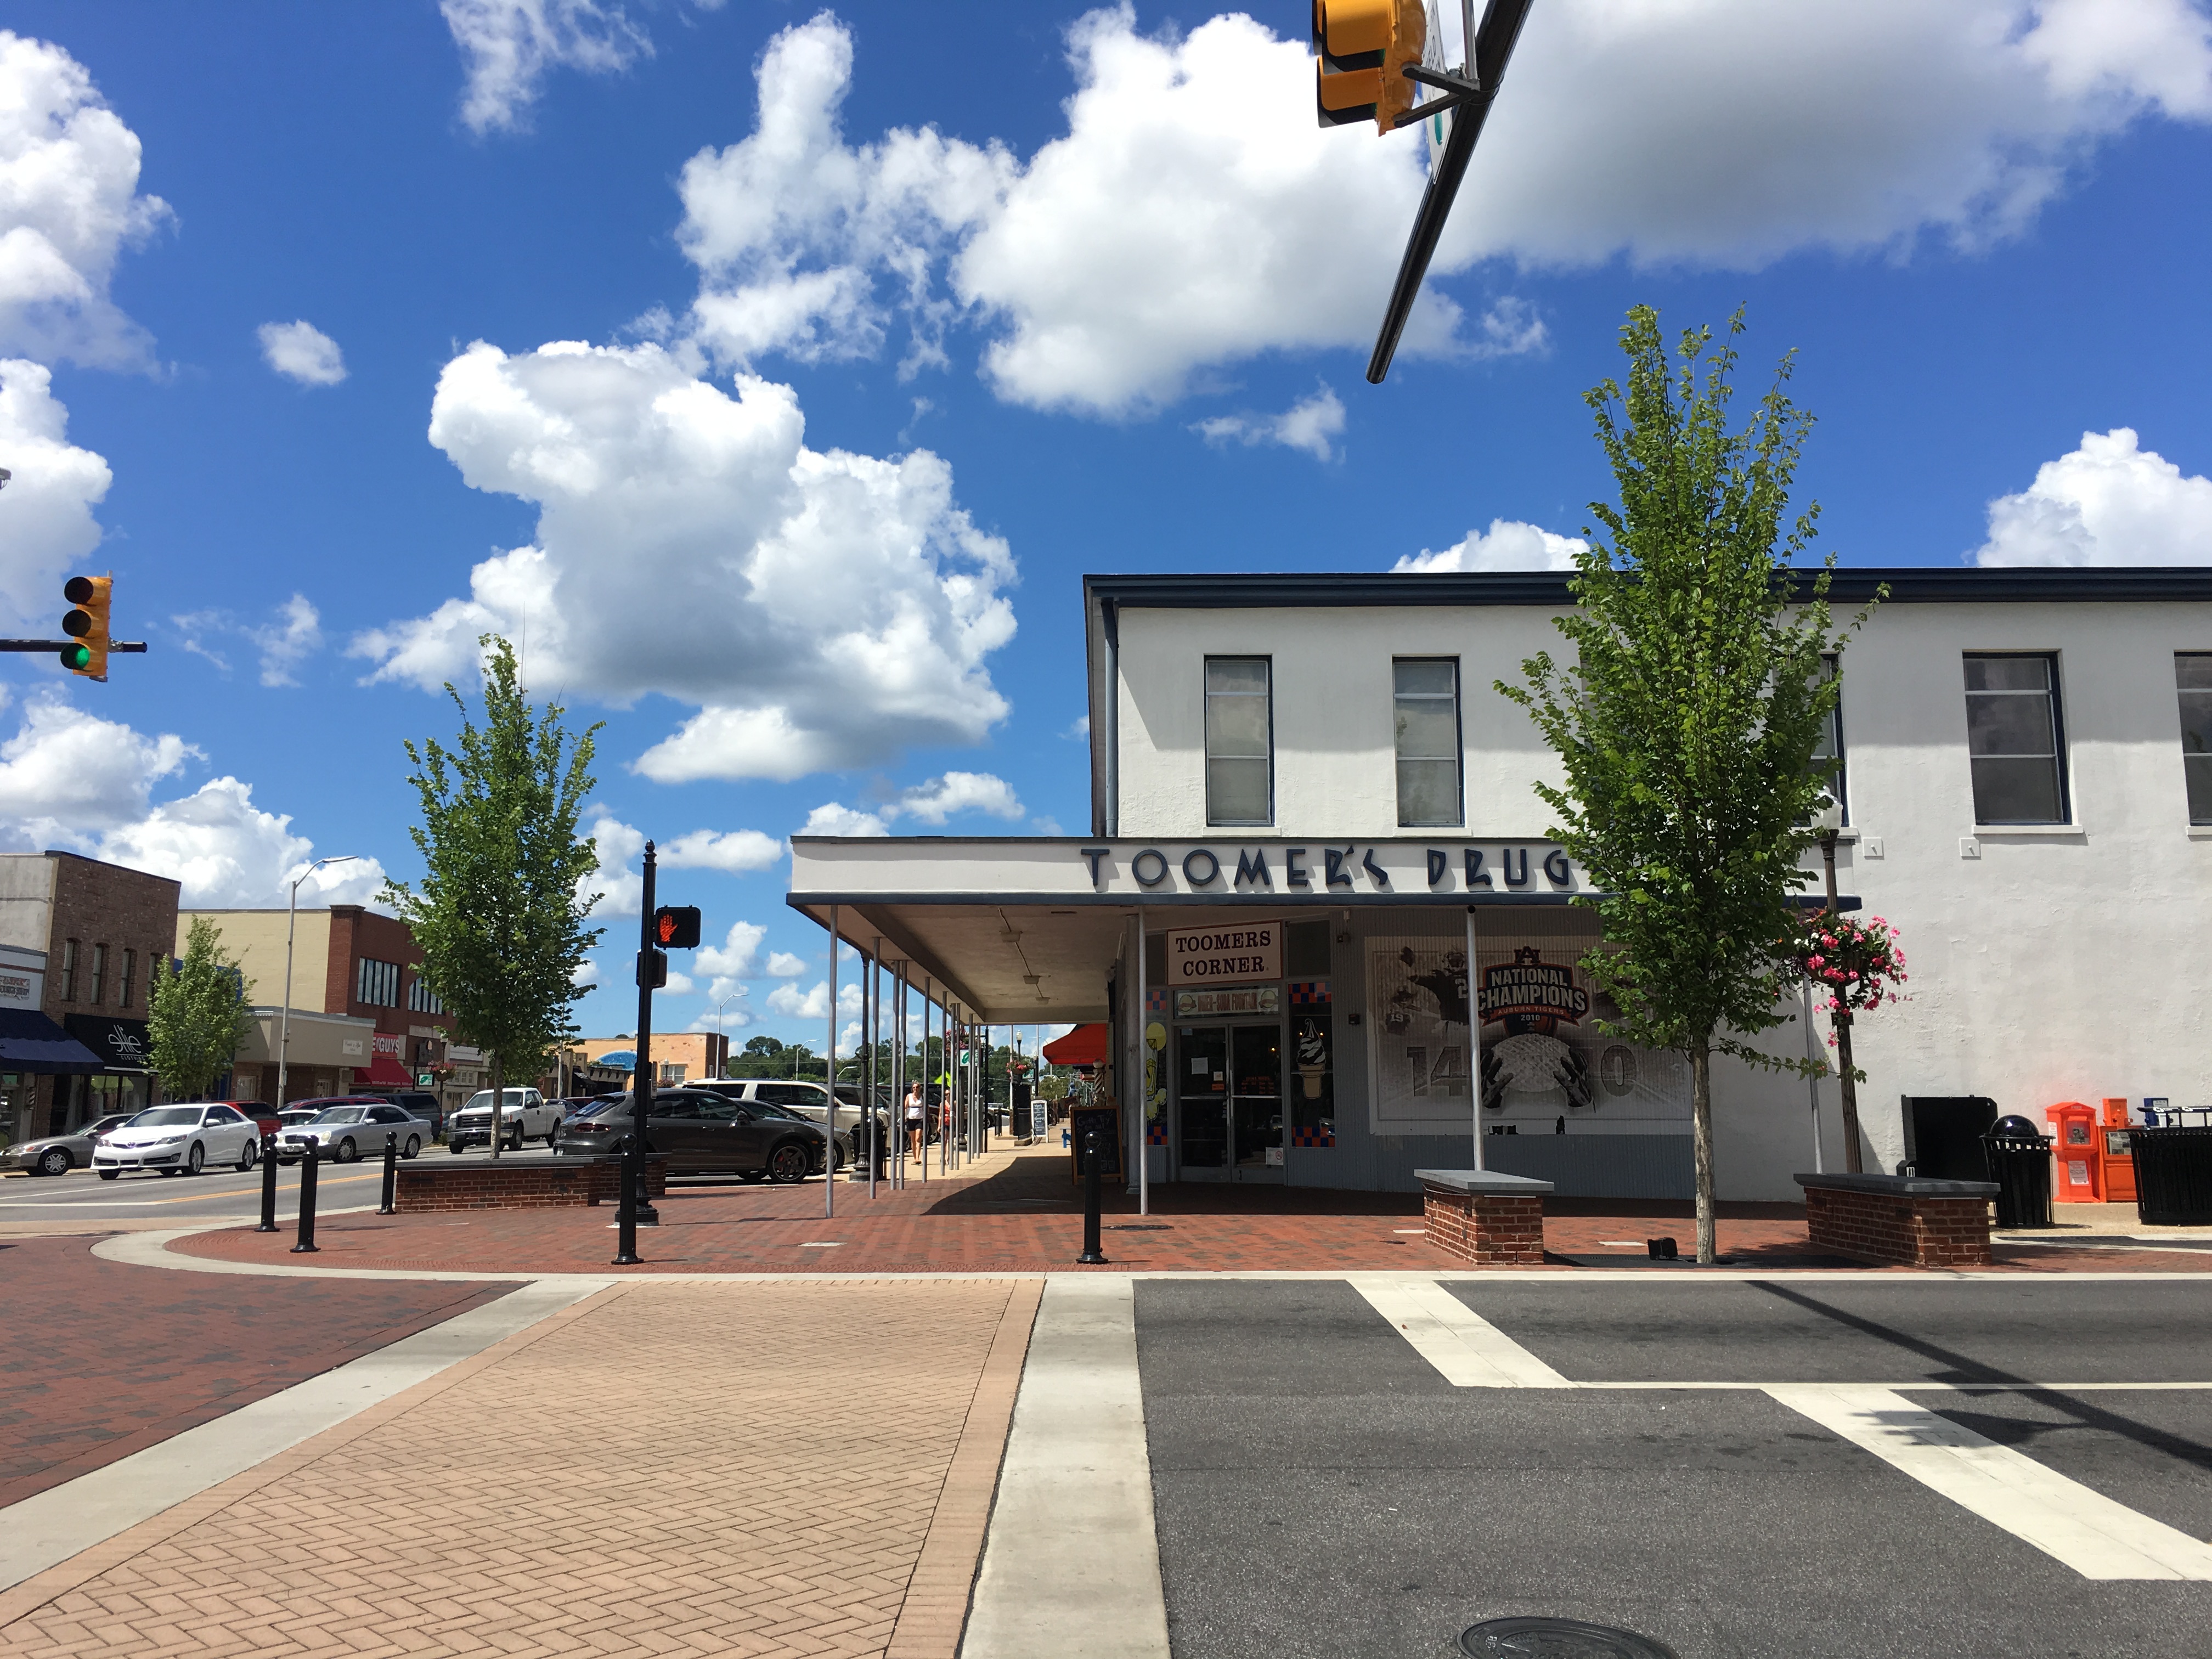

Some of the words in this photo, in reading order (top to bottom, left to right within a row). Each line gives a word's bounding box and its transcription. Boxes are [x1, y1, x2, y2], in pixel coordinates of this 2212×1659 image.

[1081, 845, 1389, 886] TOOMER'S
[1427, 848, 1610, 885] DRUG
[1176, 930, 1271, 953] TOOMERS
[1183, 956, 1265, 977] CORNER
[1491, 968, 1568, 986] NATIONAL
[1478, 985, 1585, 1011] CHAMPIONS
[1498, 1006, 1531, 1015] AUBURN
[1534, 1006, 1564, 1015] TIGERS
[379, 1037, 400, 1053] GUYS
[1407, 1046, 1468, 1097] 14
